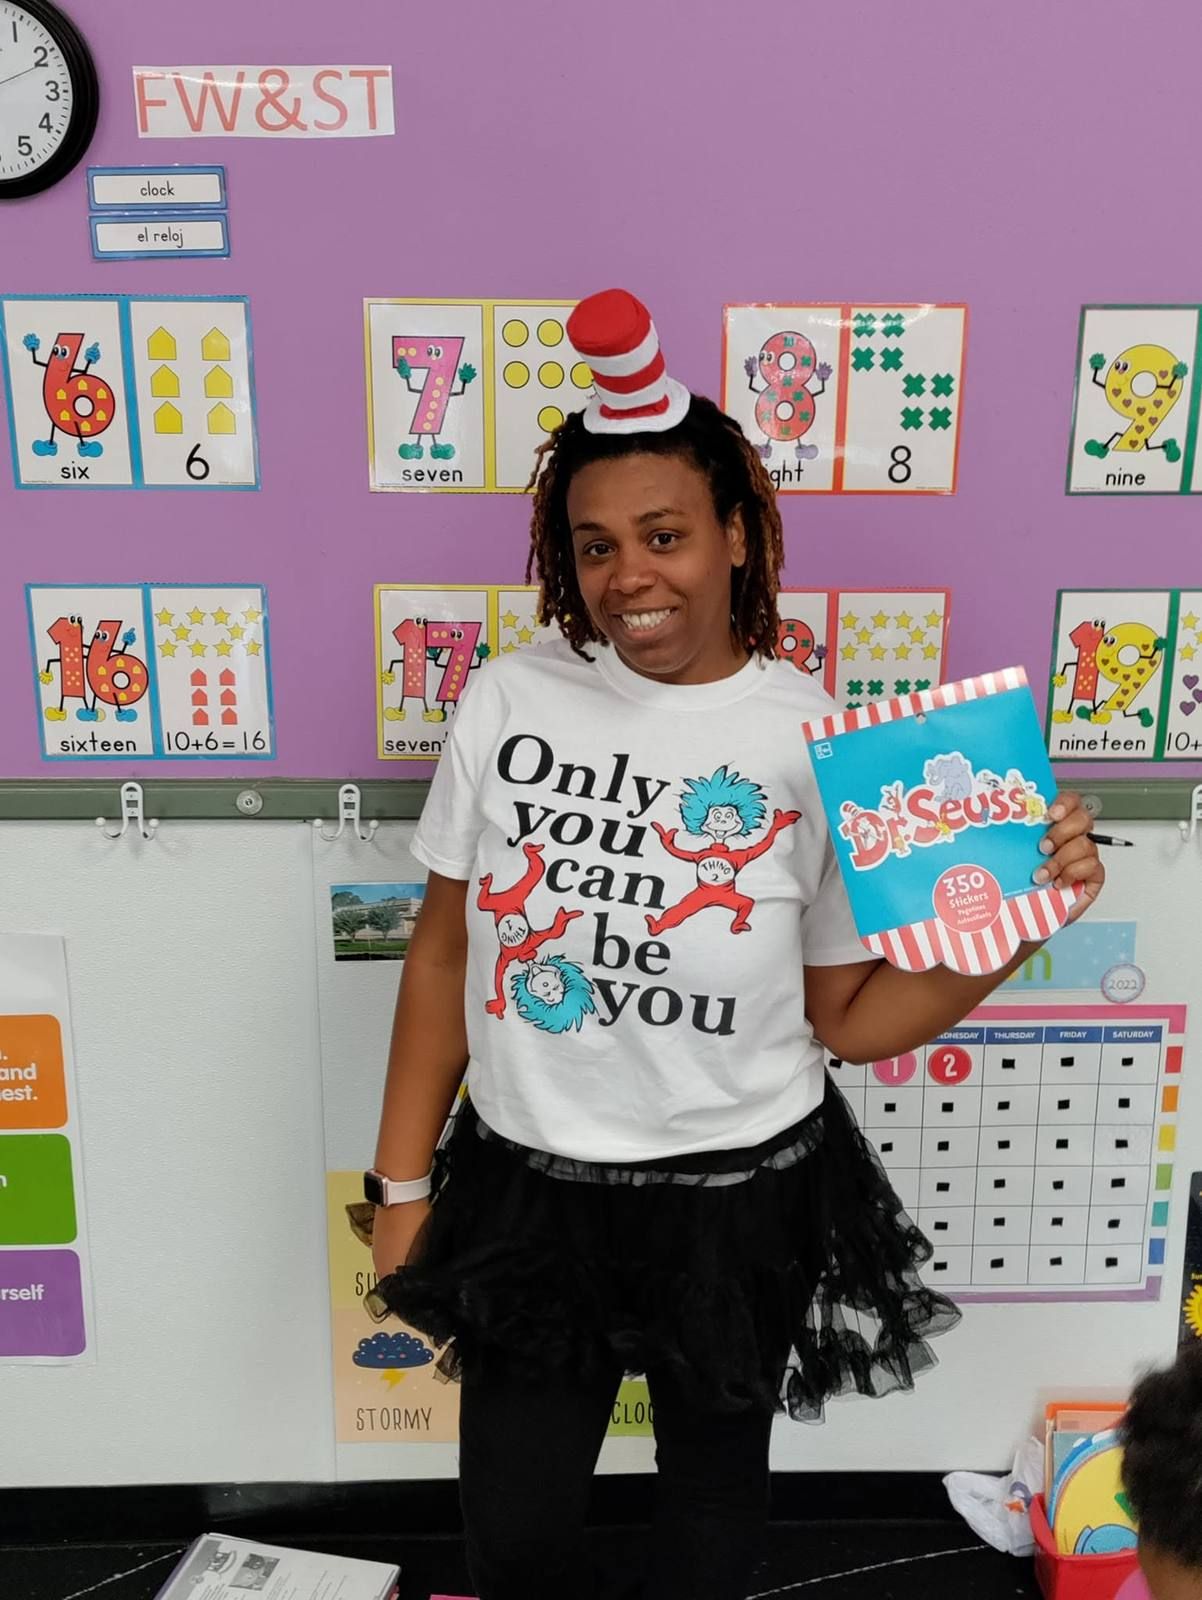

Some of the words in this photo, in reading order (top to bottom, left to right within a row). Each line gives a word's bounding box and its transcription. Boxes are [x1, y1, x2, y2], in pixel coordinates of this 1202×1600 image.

[12, 21, 18, 43] 1
[34, 46, 49, 68] 2
[45, 80, 60, 102] 3
[136, 68, 390, 133] FW&ST
[38, 112, 54, 134] 4
[18, 135, 33, 156] 5
[140, 182, 175, 197] clock
[137, 229, 149, 243] el
[153, 229, 184, 249] reloj
[61, 461, 90, 480] six
[186, 443, 210, 481] 6
[888, 445, 912, 484] 8
[402, 467, 463, 483] seven
[769, 459, 804, 492] ght
[1105, 469, 1146, 488] nine
[60, 731, 137, 752] sixteen
[1059, 730, 1146, 751] nineteen
[497, 734, 671, 819] Only
[507, 800, 647, 857] you
[842, 808, 912, 868] Dr.
[906, 787, 1030, 844] Seuss
[545, 857, 666, 910] can
[943, 871, 985, 897] 350
[949, 892, 989, 909] Stickers
[592, 912, 671, 976] be
[1108, 979, 1138, 990] 2022
[591, 977, 736, 1036] you
[993, 1031, 1036, 1040] THURSDAY
[1059, 1031, 1087, 1039] FRIDAY
[1112, 1030, 1154, 1039] SATURDAY
[0, 1062, 37, 1081] and
[889, 1056, 899, 1077] 1
[943, 1053, 957, 1077] 2
[0, 1085, 38, 1101] est.
[0, 1284, 44, 1301] rself
[356, 1407, 432, 1431] STORMY
